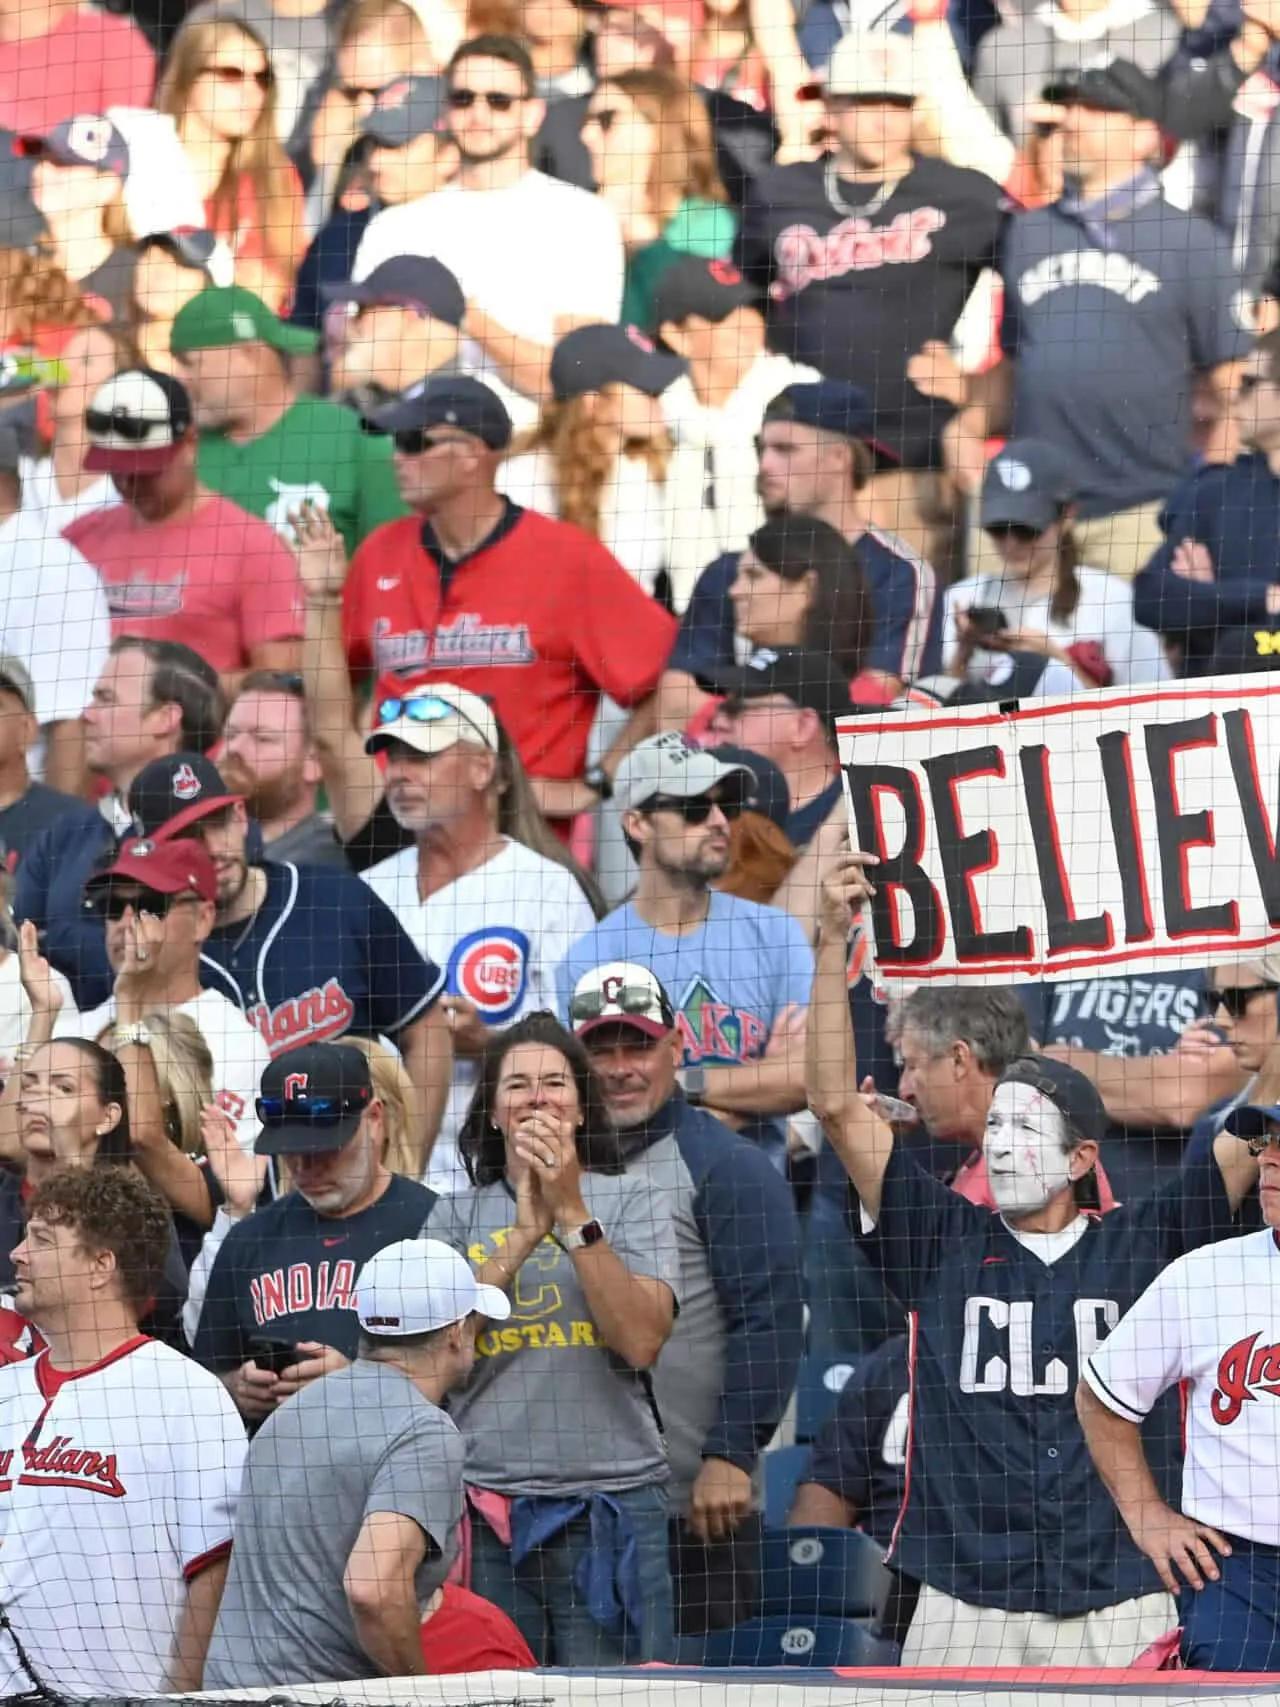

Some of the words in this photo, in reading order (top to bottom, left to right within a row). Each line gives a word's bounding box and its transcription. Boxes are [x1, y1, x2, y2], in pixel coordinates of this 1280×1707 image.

[603, 976, 624, 1004] C
[1053, 979, 1199, 1034] TIGERS
[250, 1259, 360, 1326] INDIA
[475, 1320, 601, 1358] USTAR
